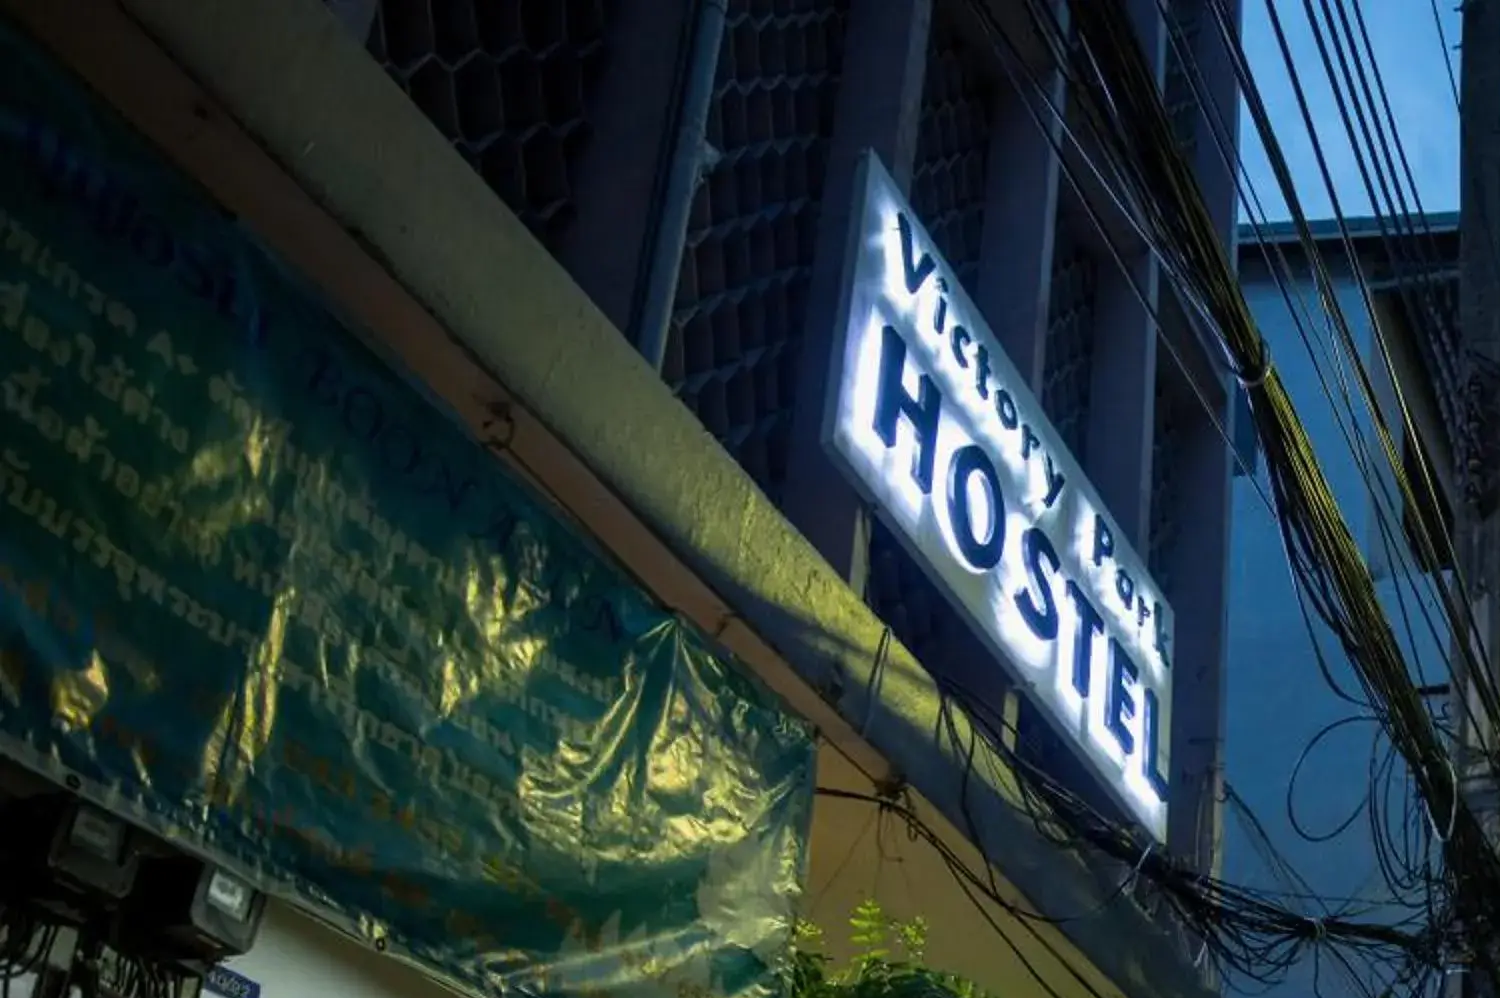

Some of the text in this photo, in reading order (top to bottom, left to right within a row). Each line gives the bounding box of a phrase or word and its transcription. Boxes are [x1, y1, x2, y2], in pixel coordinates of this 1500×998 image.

[872, 324, 1169, 803] HOSTEL
[897, 213, 1170, 668] Victory Park
